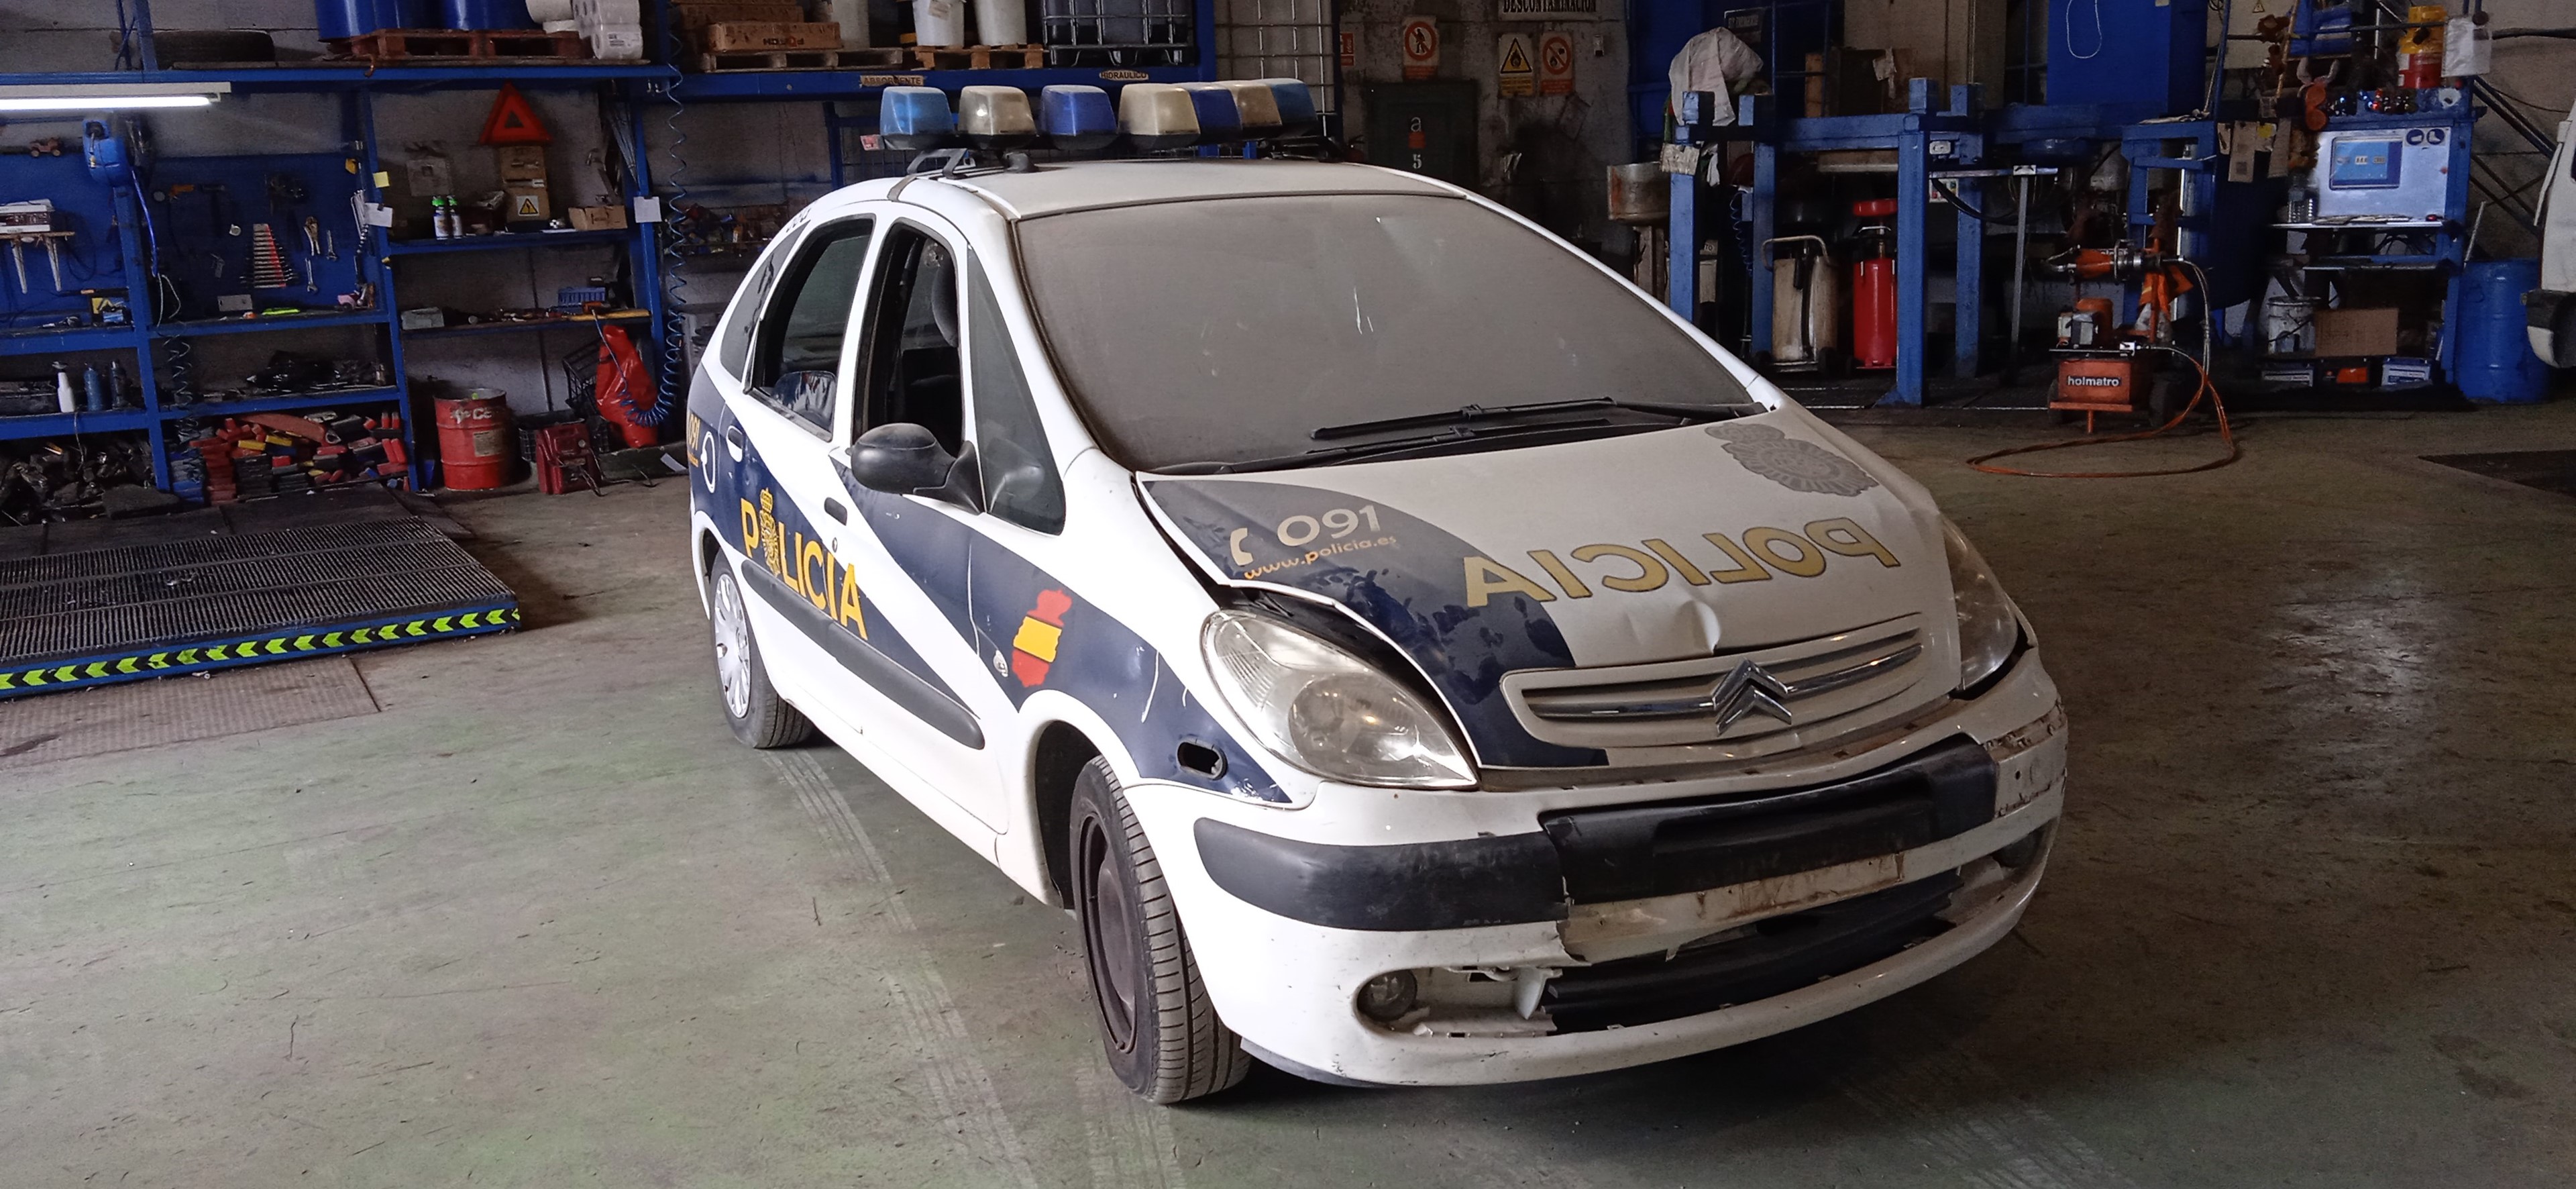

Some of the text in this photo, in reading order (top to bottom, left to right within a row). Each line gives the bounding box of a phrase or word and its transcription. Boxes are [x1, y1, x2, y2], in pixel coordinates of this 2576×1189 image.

[864, 76, 922, 85] ABSORENTE
[1412, 153, 1423, 169] 5
[2068, 376, 2120, 386] holmatro
[1277, 505, 1381, 547] 091
[1244, 535, 1397, 580] www.policia.es
